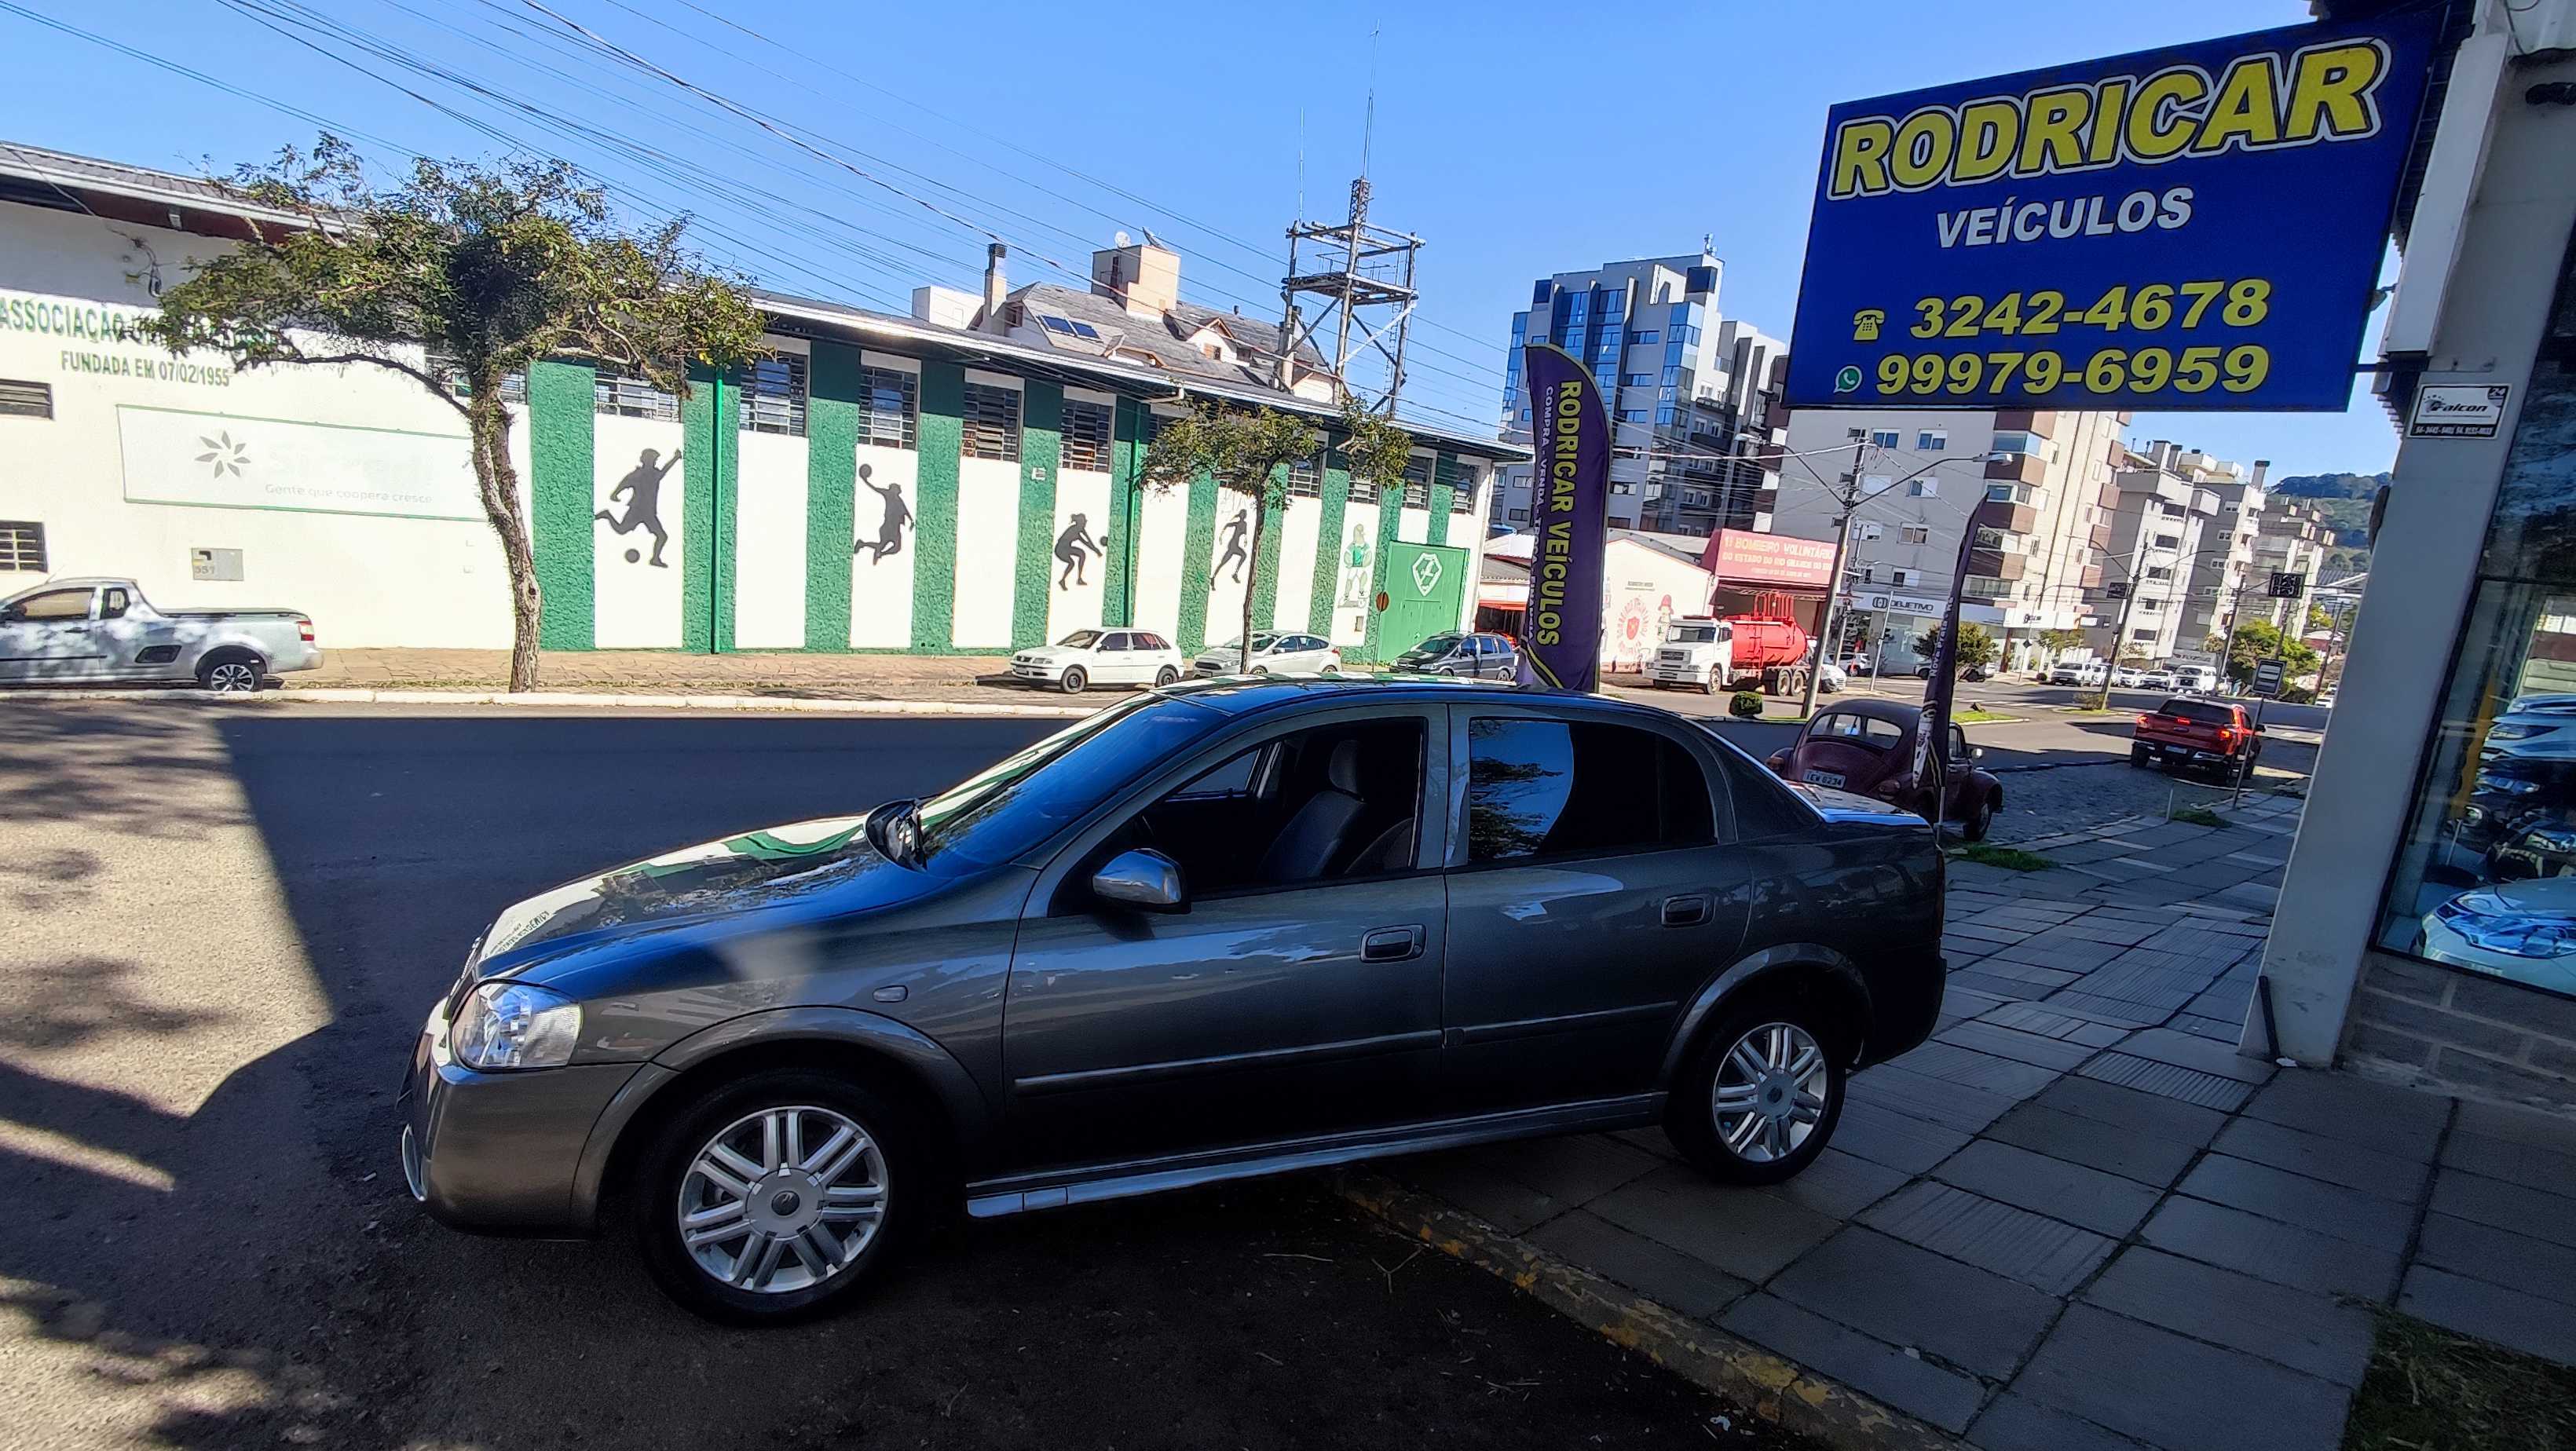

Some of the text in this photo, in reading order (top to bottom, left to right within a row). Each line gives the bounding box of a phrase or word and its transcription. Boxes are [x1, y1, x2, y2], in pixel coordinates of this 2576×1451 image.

[1828, 39, 2392, 199] RODRICAR
[1937, 187, 2194, 248] VEÍCULOS
[1910, 278, 2271, 338] 3242-4678
[61, 350, 230, 386] FUNDADA EM 07/02/1955
[1875, 344, 2270, 395] 99979-6959
[1542, 386, 1553, 447] COMPRA
[2431, 401, 2488, 412] Falcon
[265, 484, 305, 495] Gente
[309, 488, 333, 499] que
[336, 490, 390, 501] coopera
[1537, 459, 1548, 506] VENDA
[1537, 381, 1582, 645] RODRICAR VEÍCULOS
[1735, 537, 1779, 554] BOMBEIRO
[1890, 600, 1934, 611] OBJETIVO
